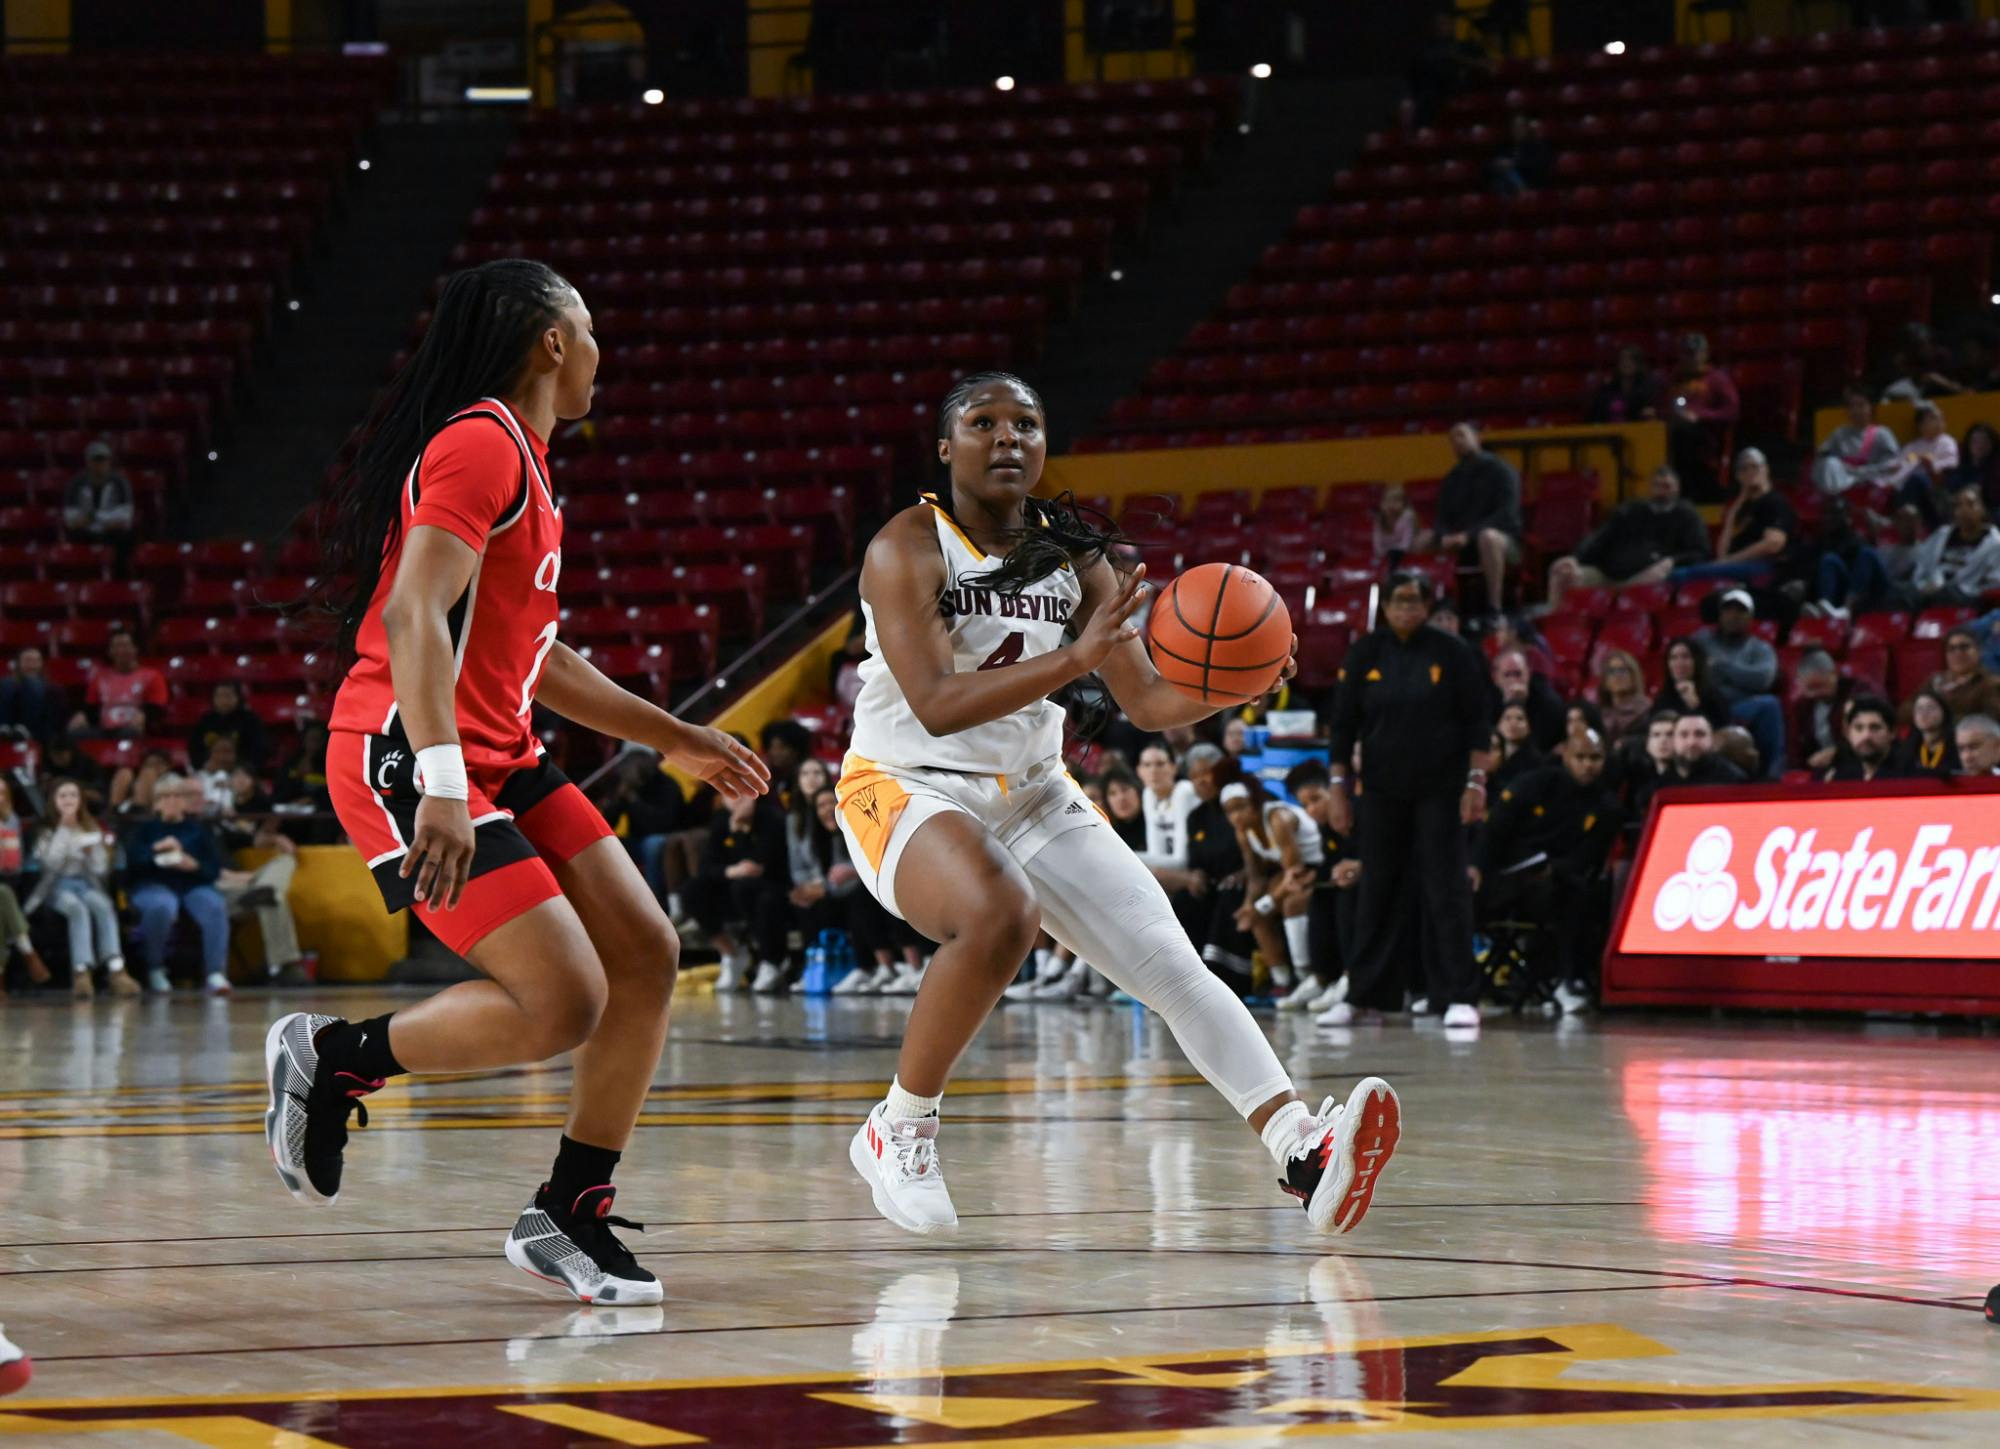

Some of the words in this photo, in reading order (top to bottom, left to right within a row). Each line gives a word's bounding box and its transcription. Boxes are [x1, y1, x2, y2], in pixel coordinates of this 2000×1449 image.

[938, 588, 992, 617] SUN
[1000, 593, 1071, 625] DEVILS
[977, 631, 1025, 671] 4
